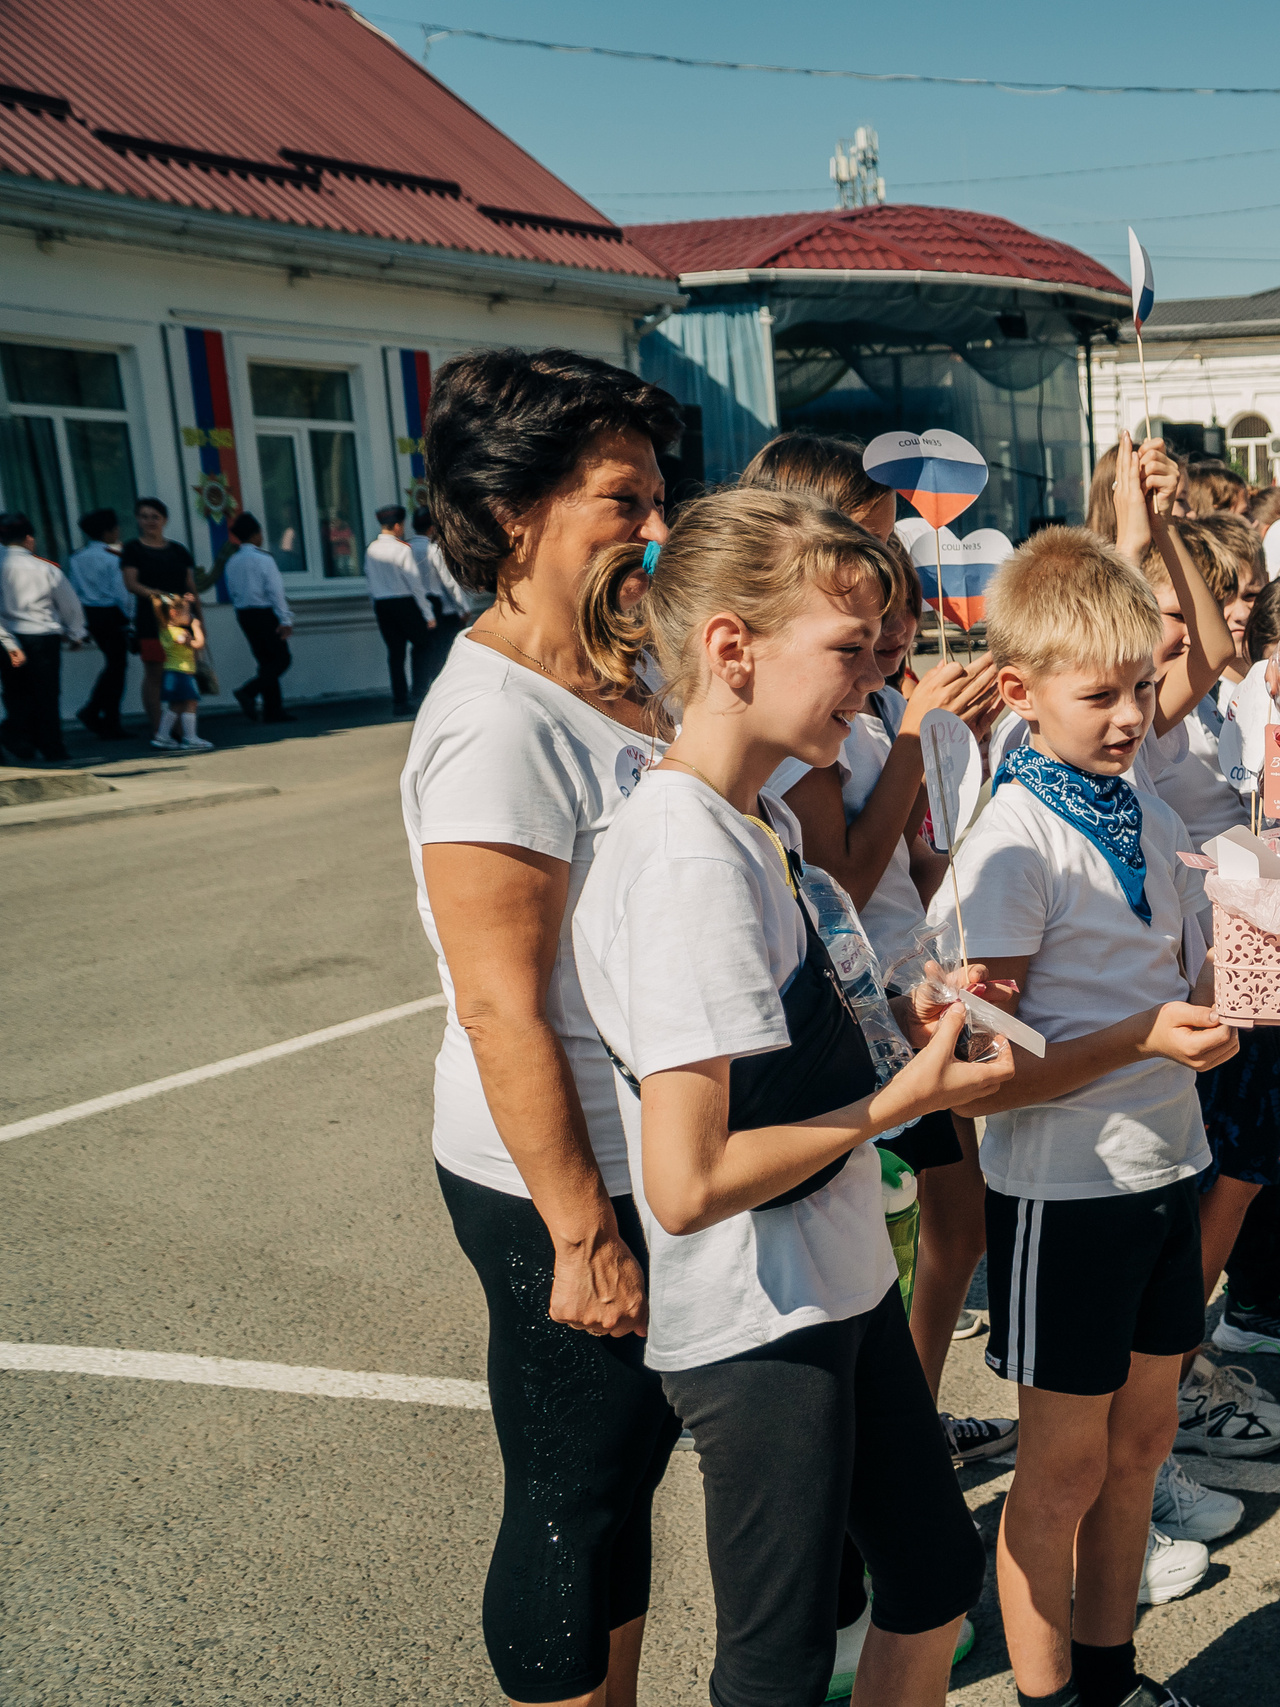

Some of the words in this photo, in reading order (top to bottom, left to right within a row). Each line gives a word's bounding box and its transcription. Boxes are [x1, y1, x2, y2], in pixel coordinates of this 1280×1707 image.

[898, 438, 920, 448] СОШ
[922, 438, 942, 447] №35
[941, 543, 961, 551] СОШ
[962, 543, 982, 551] №35
